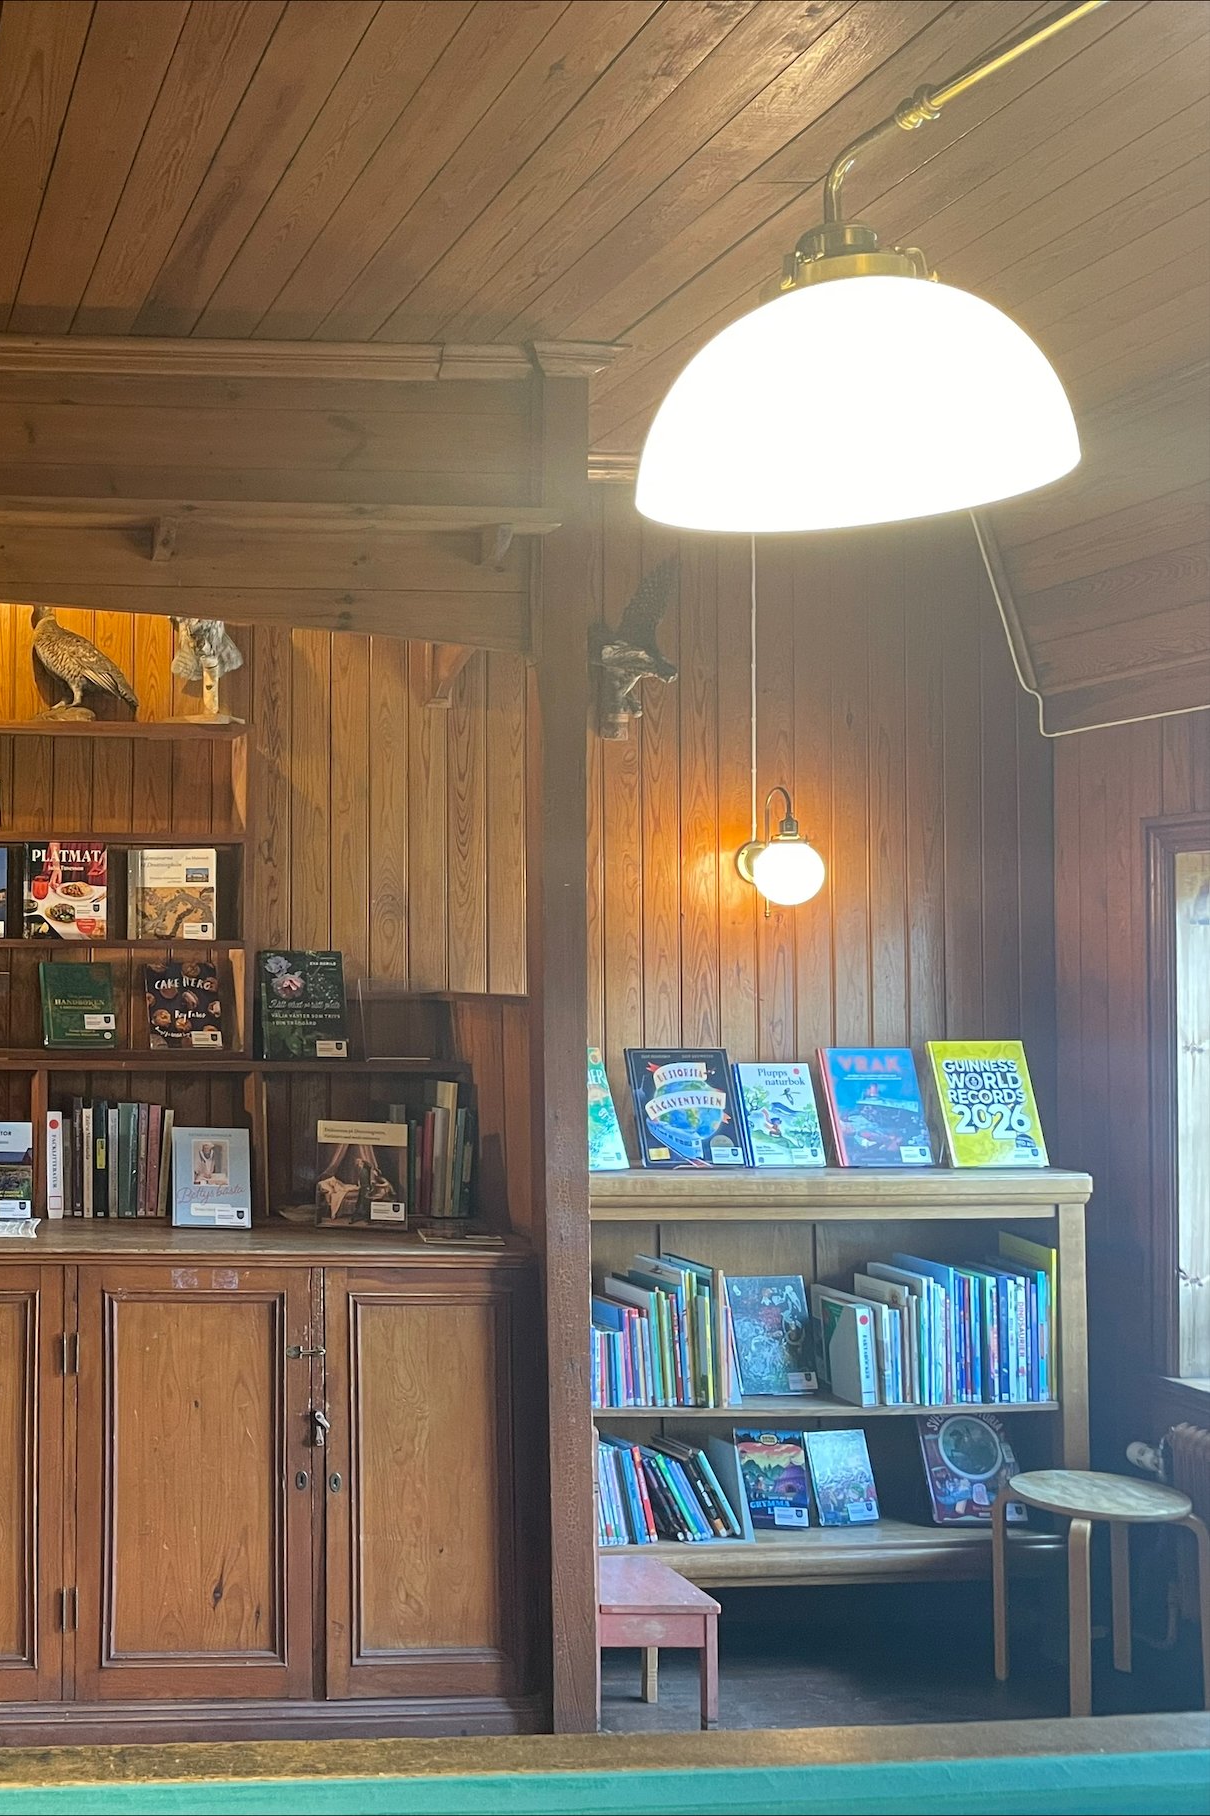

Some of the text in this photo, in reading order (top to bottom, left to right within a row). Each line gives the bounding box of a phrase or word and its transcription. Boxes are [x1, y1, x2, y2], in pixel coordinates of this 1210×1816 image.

[154, 975, 212, 991] CAKE HERO
[837, 1055, 901, 1073] VRAK
[942, 1059, 1018, 1072] GUINNESS
[757, 1068, 788, 1079] Plupps
[765, 1077, 806, 1086] naturbok
[944, 1071, 1023, 1090] WORLD
[947, 1089, 1026, 1104] RECORDS
[951, 1103, 1032, 1140] 2026
[177, 1186, 215, 1206] Bettys
[1018, 1301, 1026, 1358] DINOSAURIER
[749, 1500, 791, 1509] GRYMMA
